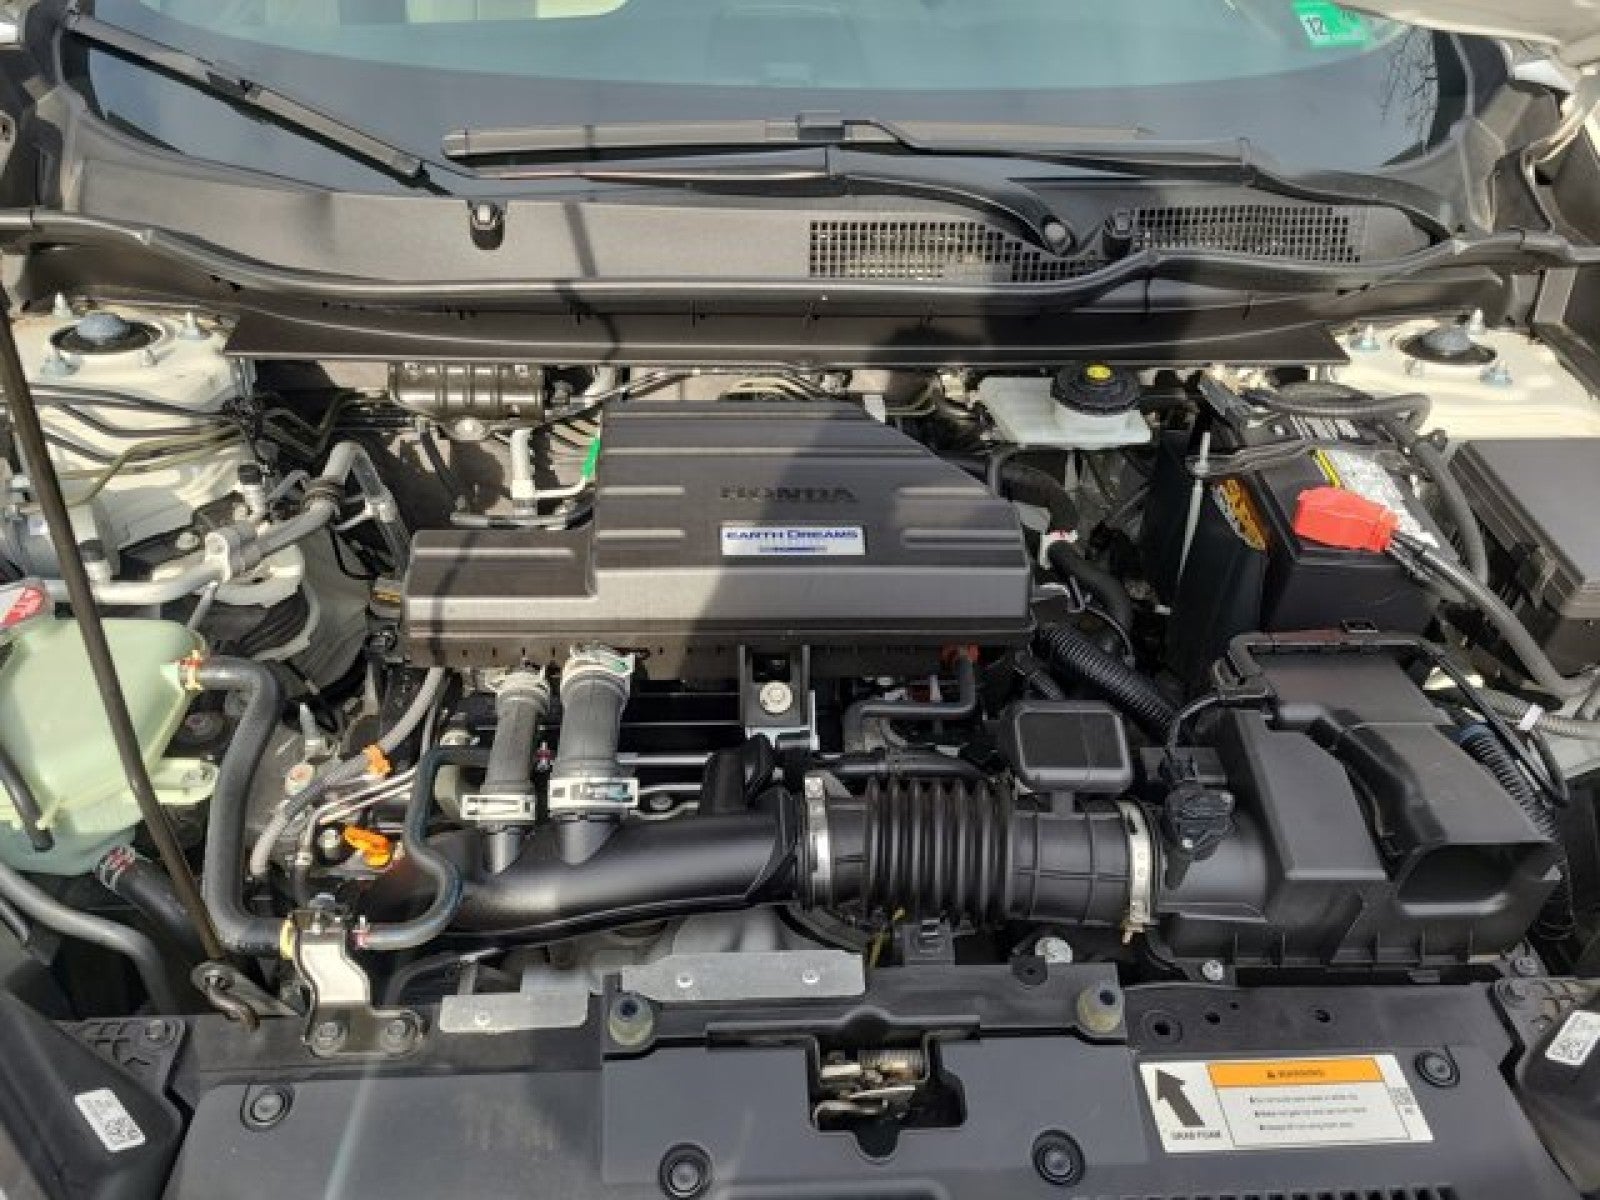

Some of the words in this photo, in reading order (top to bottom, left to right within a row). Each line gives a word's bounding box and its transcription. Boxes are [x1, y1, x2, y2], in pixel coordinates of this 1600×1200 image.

[720, 486, 858, 502] HONDA
[726, 531, 783, 540] EARTH
[787, 529, 858, 540] DREAMS
